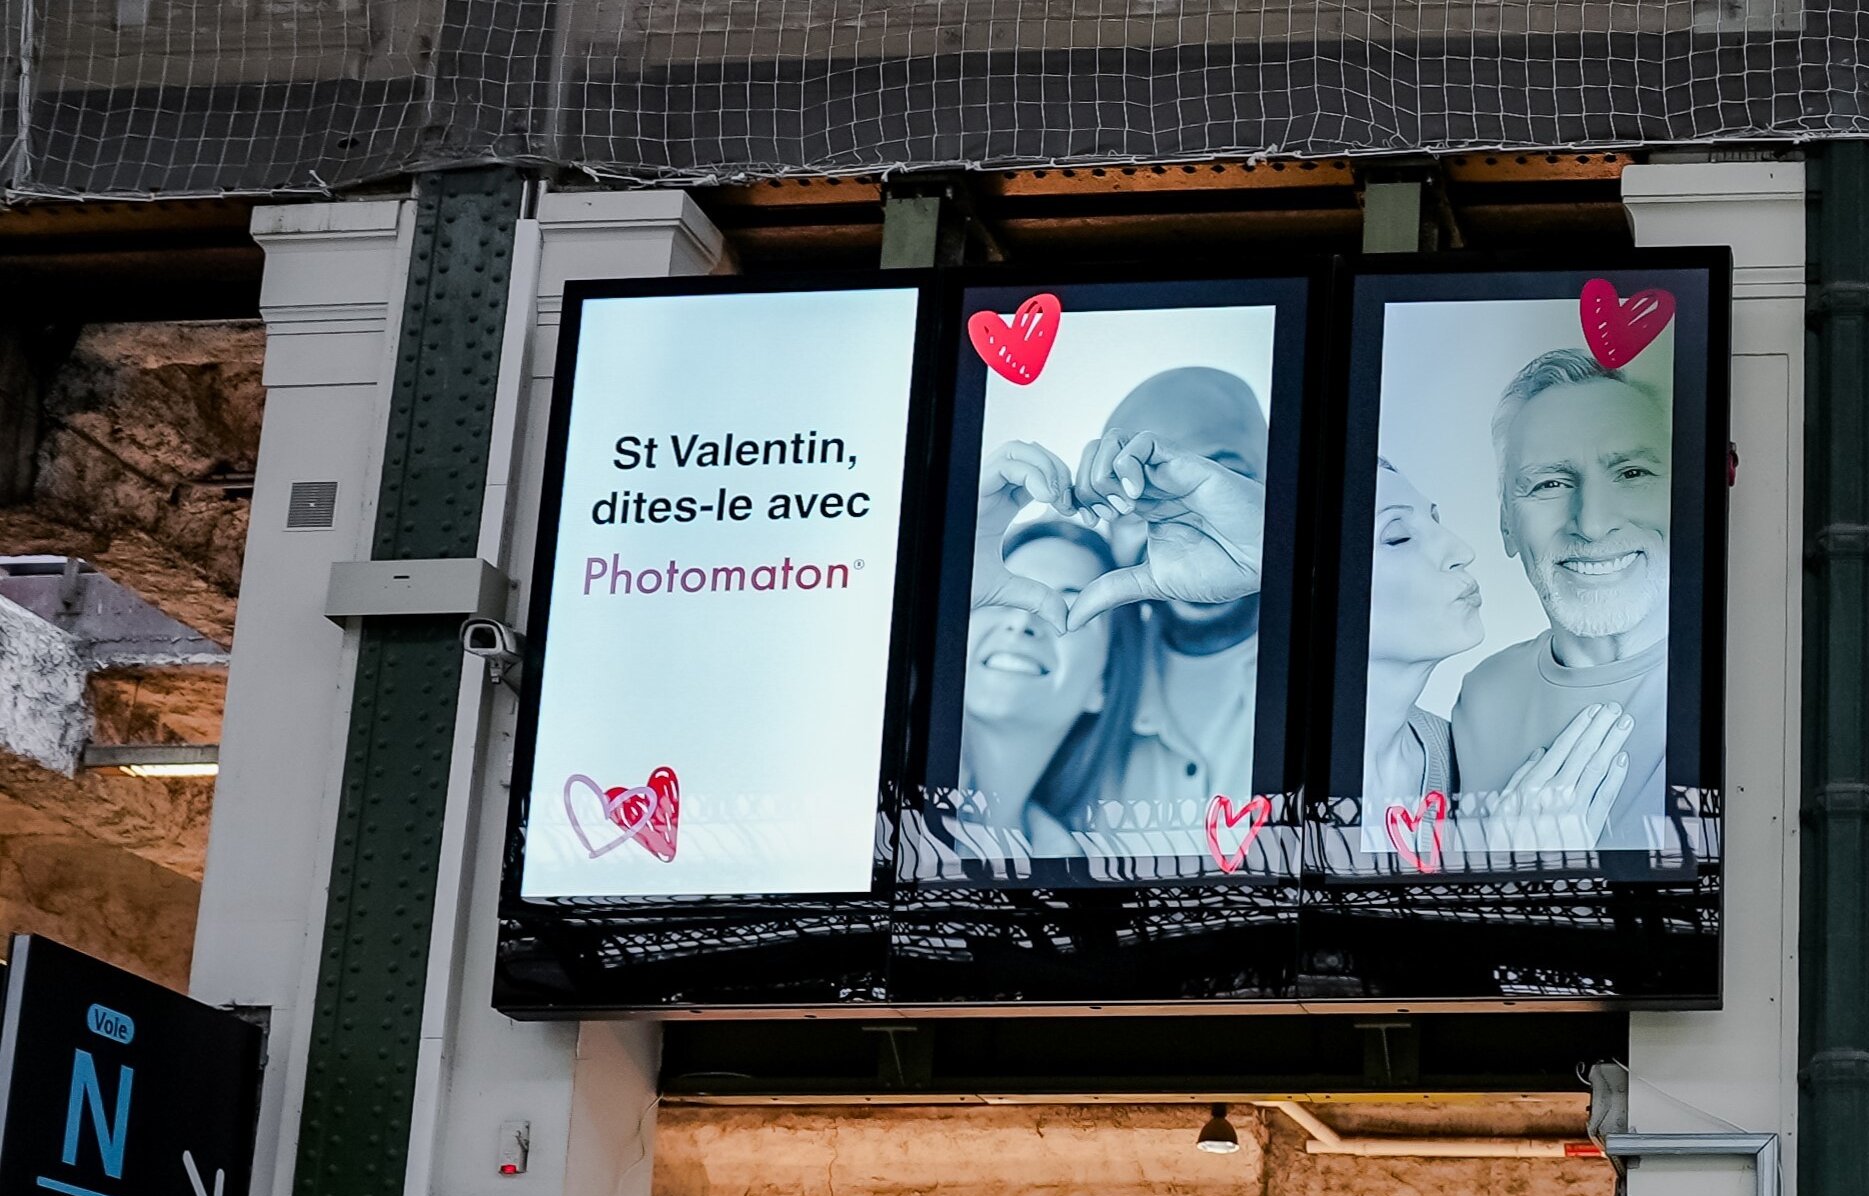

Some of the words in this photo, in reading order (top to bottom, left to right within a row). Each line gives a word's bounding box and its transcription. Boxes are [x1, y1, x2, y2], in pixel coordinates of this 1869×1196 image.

[612, 434, 657, 471] St
[671, 431, 858, 469] Valentin,
[592, 487, 752, 526] dites-le
[767, 489, 871, 520] avec
[94, 1008, 128, 1041] Voie
[62, 1048, 134, 1179] N
